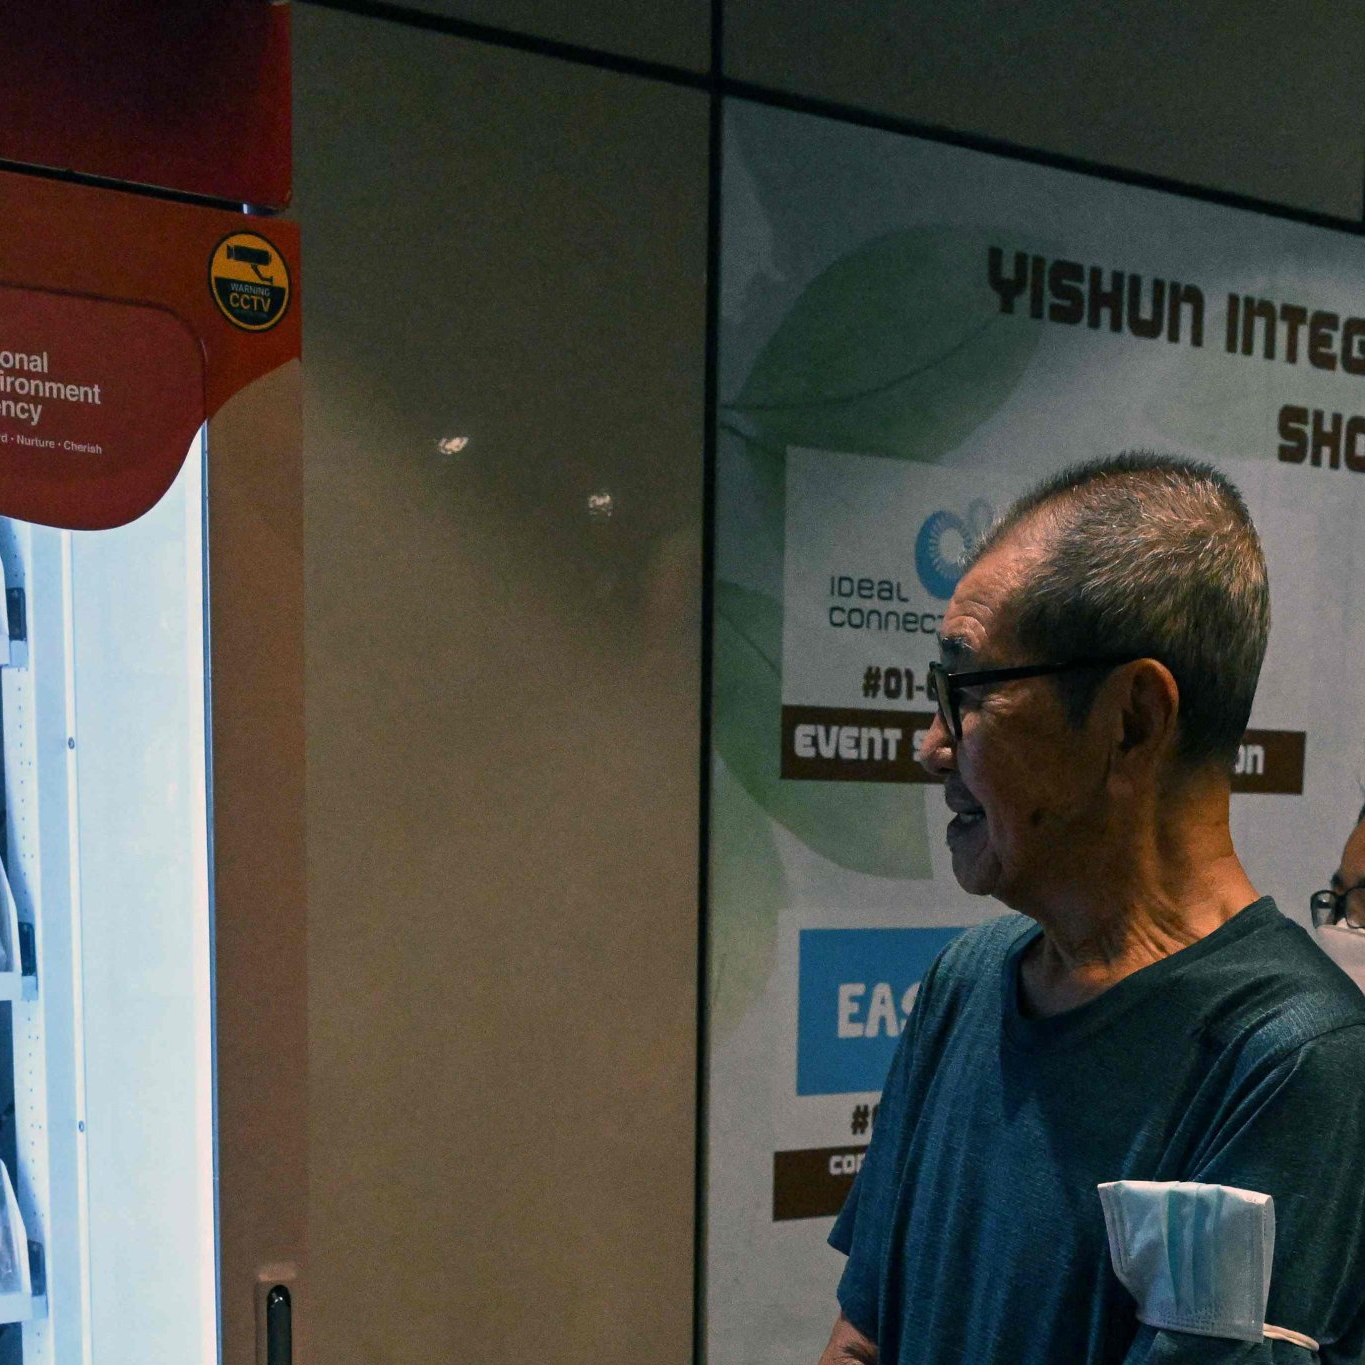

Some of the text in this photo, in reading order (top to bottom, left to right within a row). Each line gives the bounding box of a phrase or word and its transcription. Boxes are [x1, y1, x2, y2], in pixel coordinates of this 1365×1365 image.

[230, 283, 270, 296] WARNING
[988, 247, 1204, 347] YISHUN
[229, 292, 271, 313] CCTV
[17, 433, 55, 449] Nurture
[63, 439, 102, 454] Cherish
[794, 723, 900, 762] EVENT
